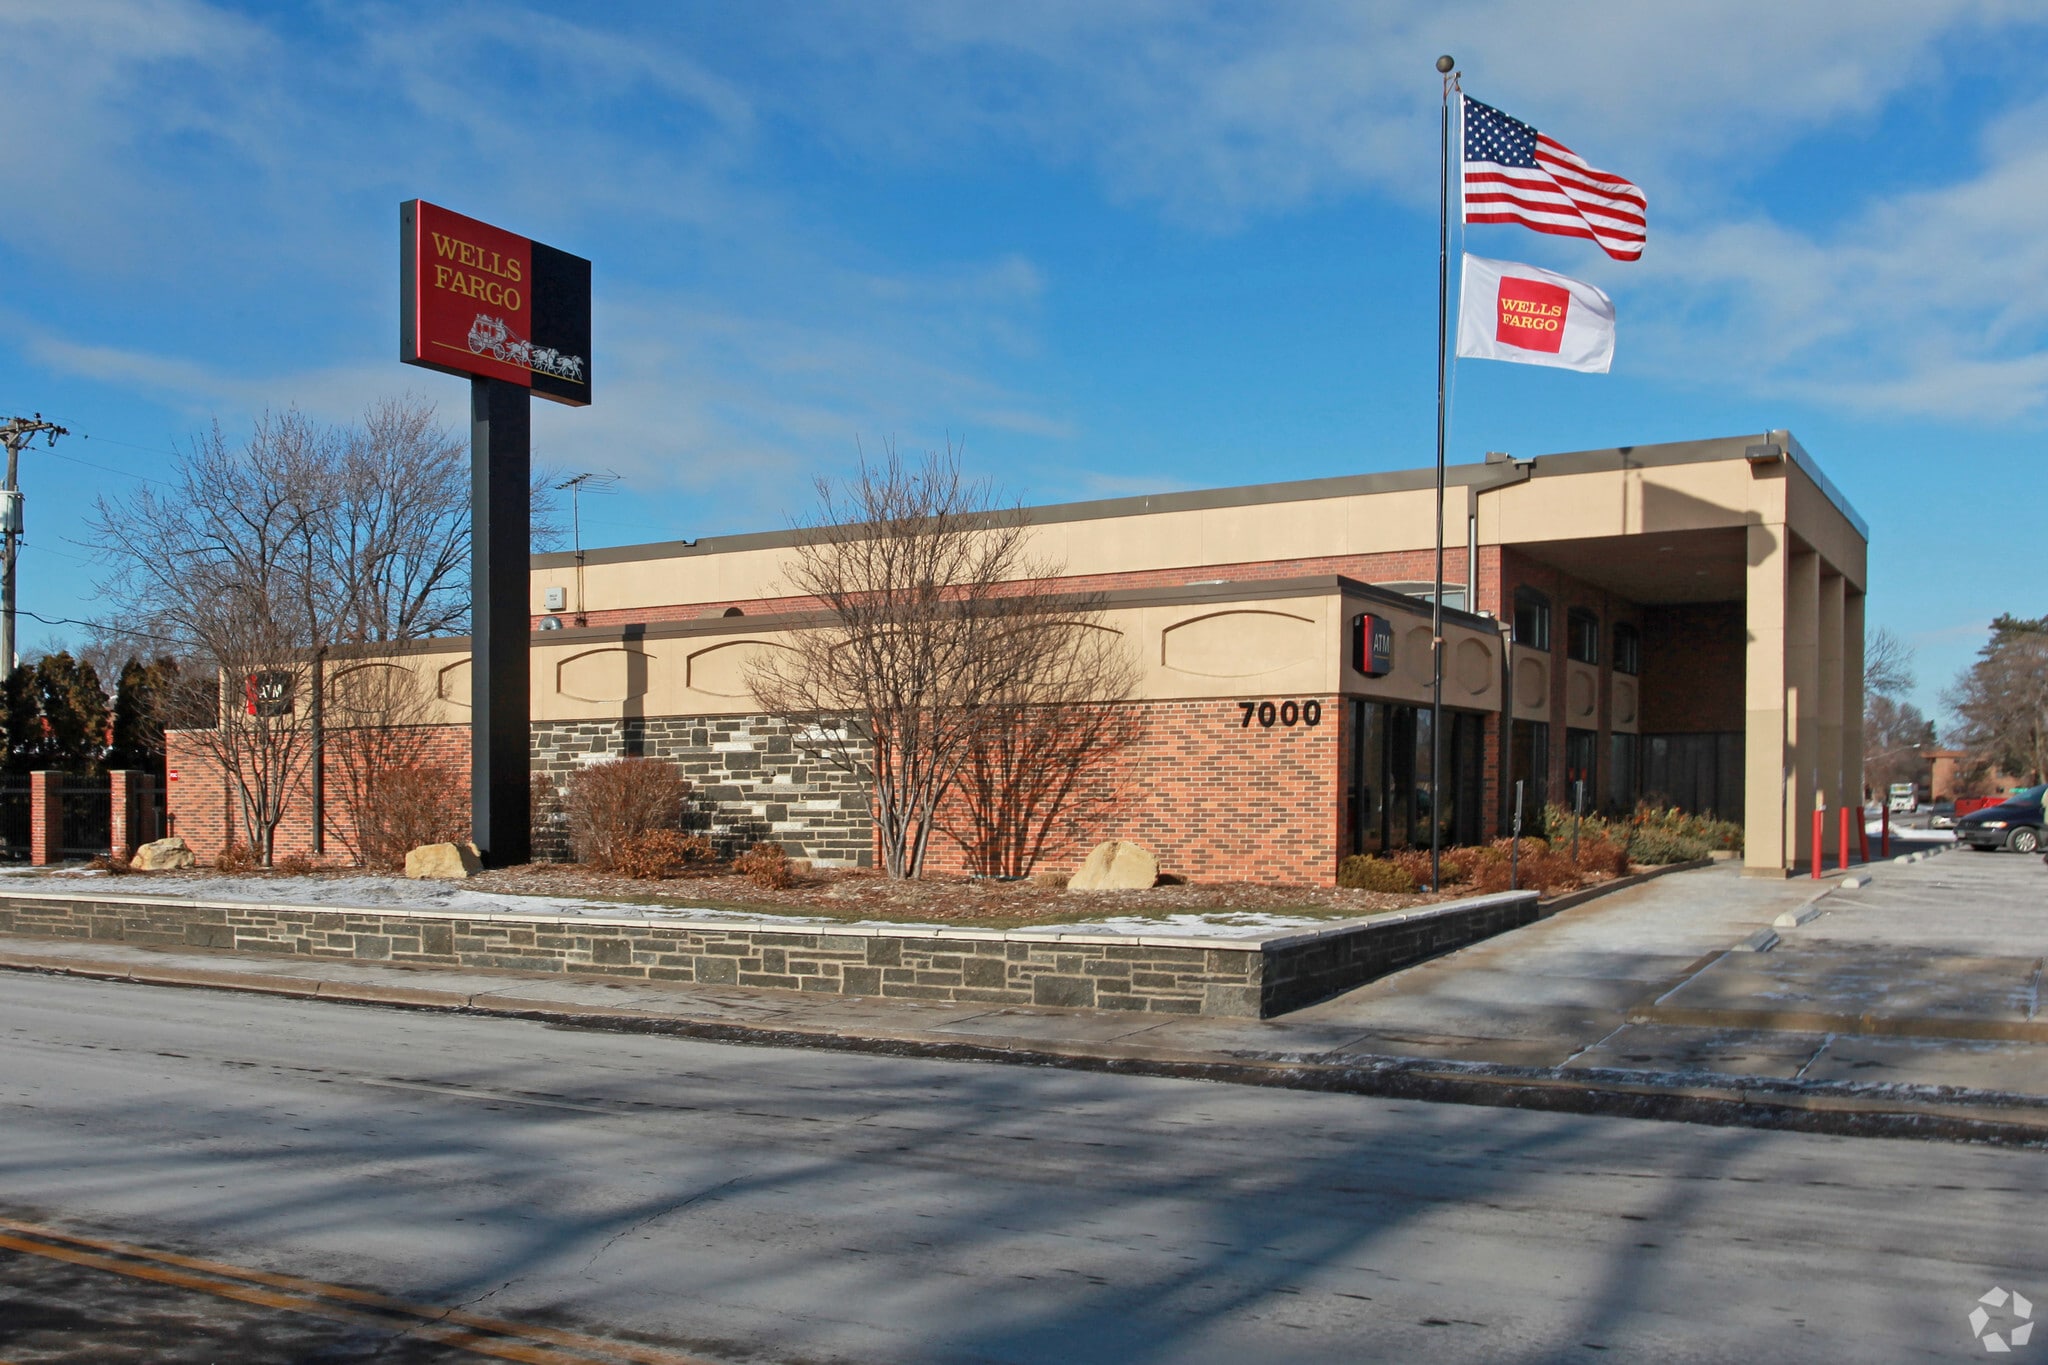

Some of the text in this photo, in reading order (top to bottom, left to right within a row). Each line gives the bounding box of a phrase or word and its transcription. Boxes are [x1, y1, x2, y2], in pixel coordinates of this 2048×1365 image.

[432, 232, 521, 282] WELLS
[434, 264, 521, 310] FARGO
[1501, 299, 1562, 317] WELLS
[1503, 314, 1558, 331] FARGO
[1373, 633, 1390, 653] ATM
[1239, 700, 1321, 727] 7000
